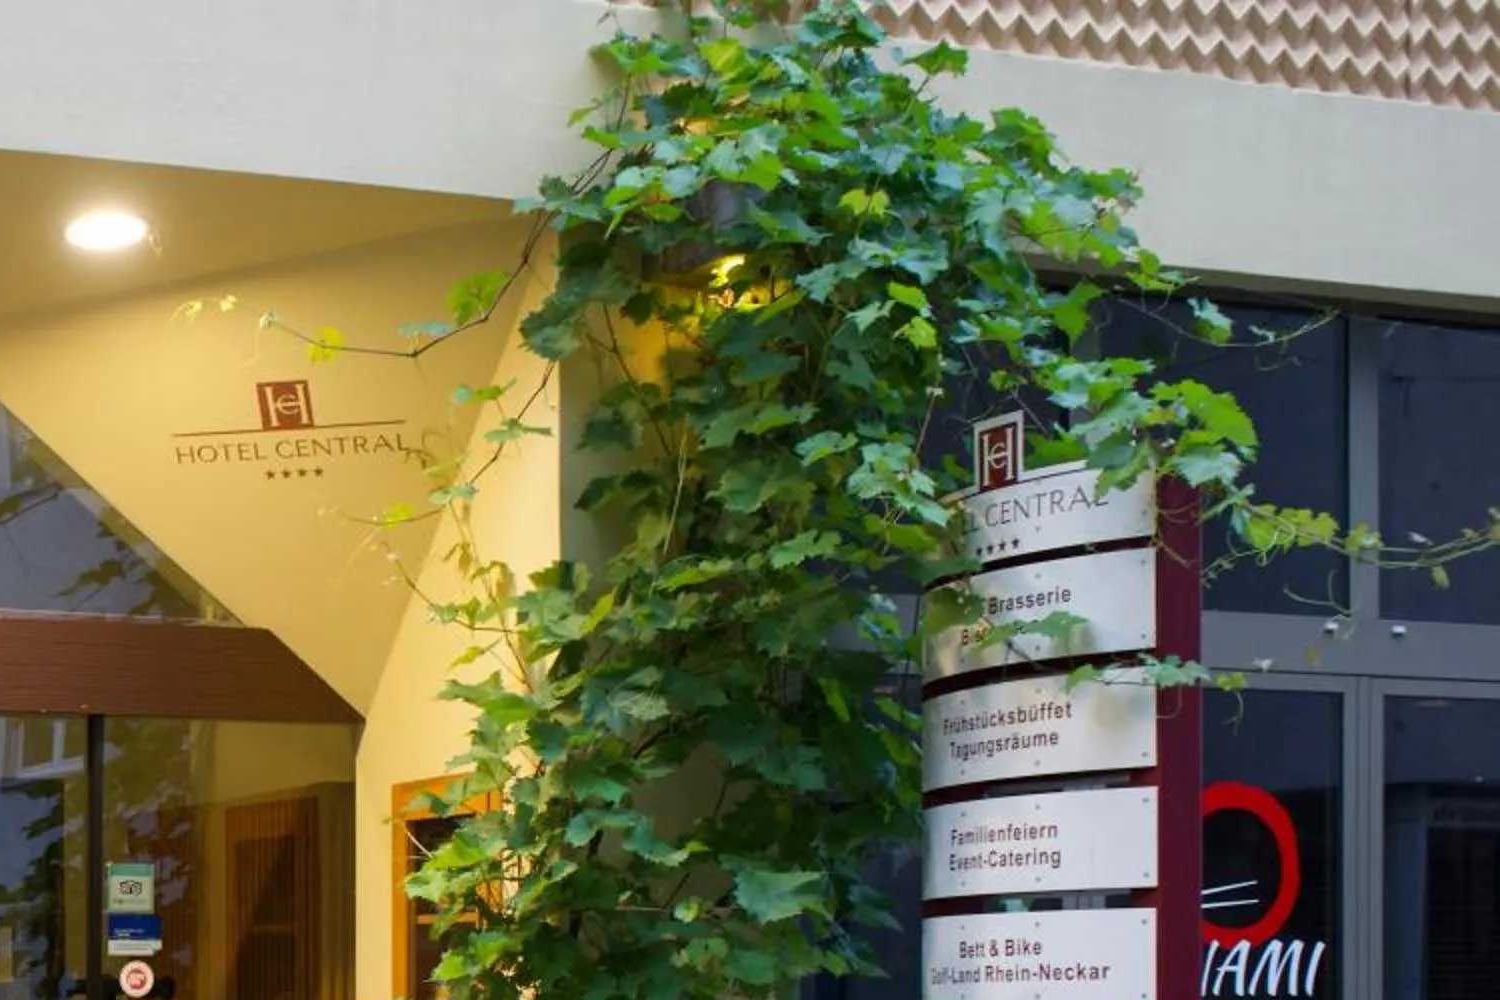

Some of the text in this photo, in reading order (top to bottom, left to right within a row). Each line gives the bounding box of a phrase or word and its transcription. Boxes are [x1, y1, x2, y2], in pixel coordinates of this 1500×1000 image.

[175, 433, 411, 465] HOTEL CENTRAL
[987, 585, 1073, 615] Brasserie
[943, 701, 1074, 736] Frühstücksbüffet
[949, 731, 1060, 761] Tagungsräume
[950, 823, 1058, 846] Familienfeiern
[949, 848, 1062, 871] Event-Catering
[959, 938, 1043, 959] Bett & Bike
[984, 963, 1112, 983] Rhein-Neckar
